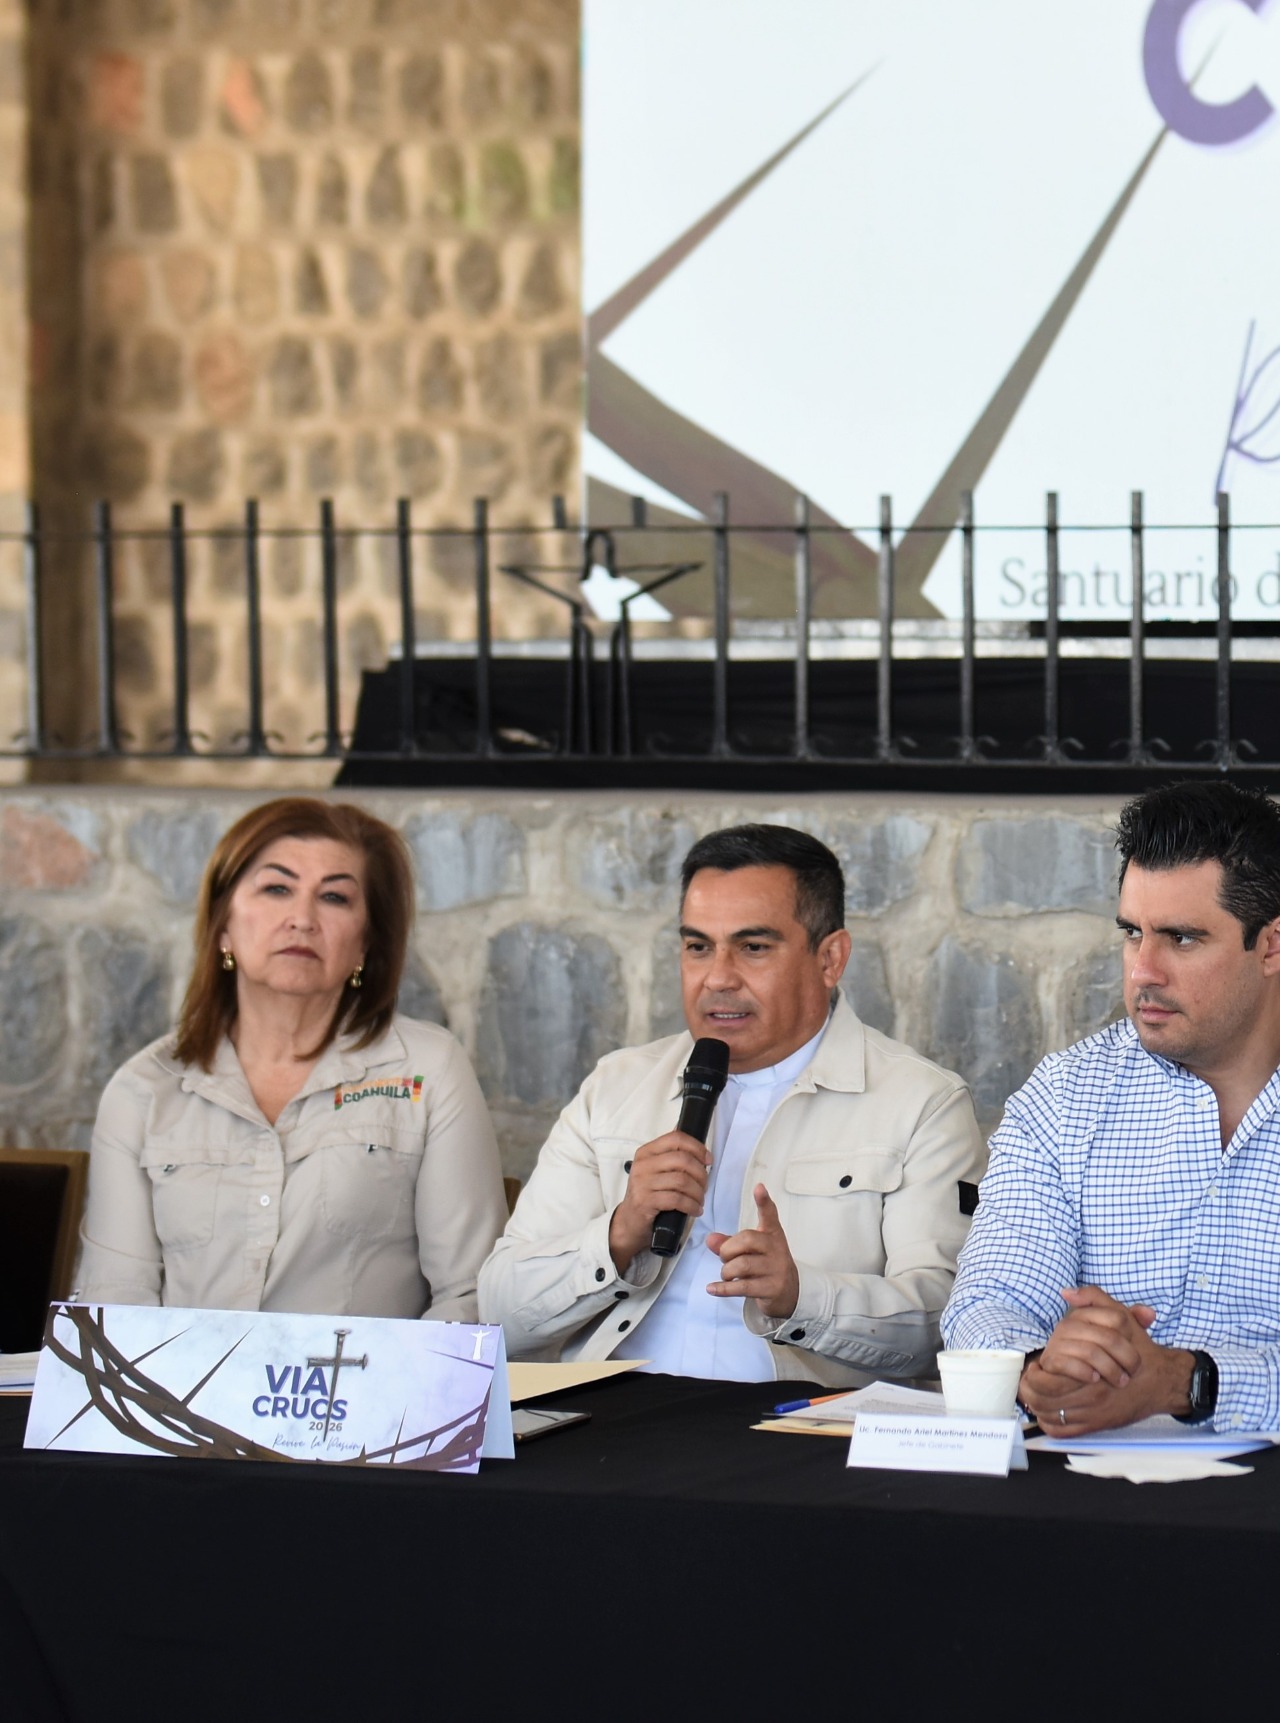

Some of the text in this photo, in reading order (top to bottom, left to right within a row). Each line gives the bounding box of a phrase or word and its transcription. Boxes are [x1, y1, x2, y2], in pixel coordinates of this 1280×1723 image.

[1000, 557, 1239, 608] Santuario
[343, 1085, 411, 1103] COAHUILA
[265, 1364, 328, 1396] VIA
[308, 1421, 343, 1432] 2026
[874, 1426, 912, 1435] Fernando
[914, 1427, 932, 1435] Ariel
[970, 1430, 1008, 1440] Mendoza
